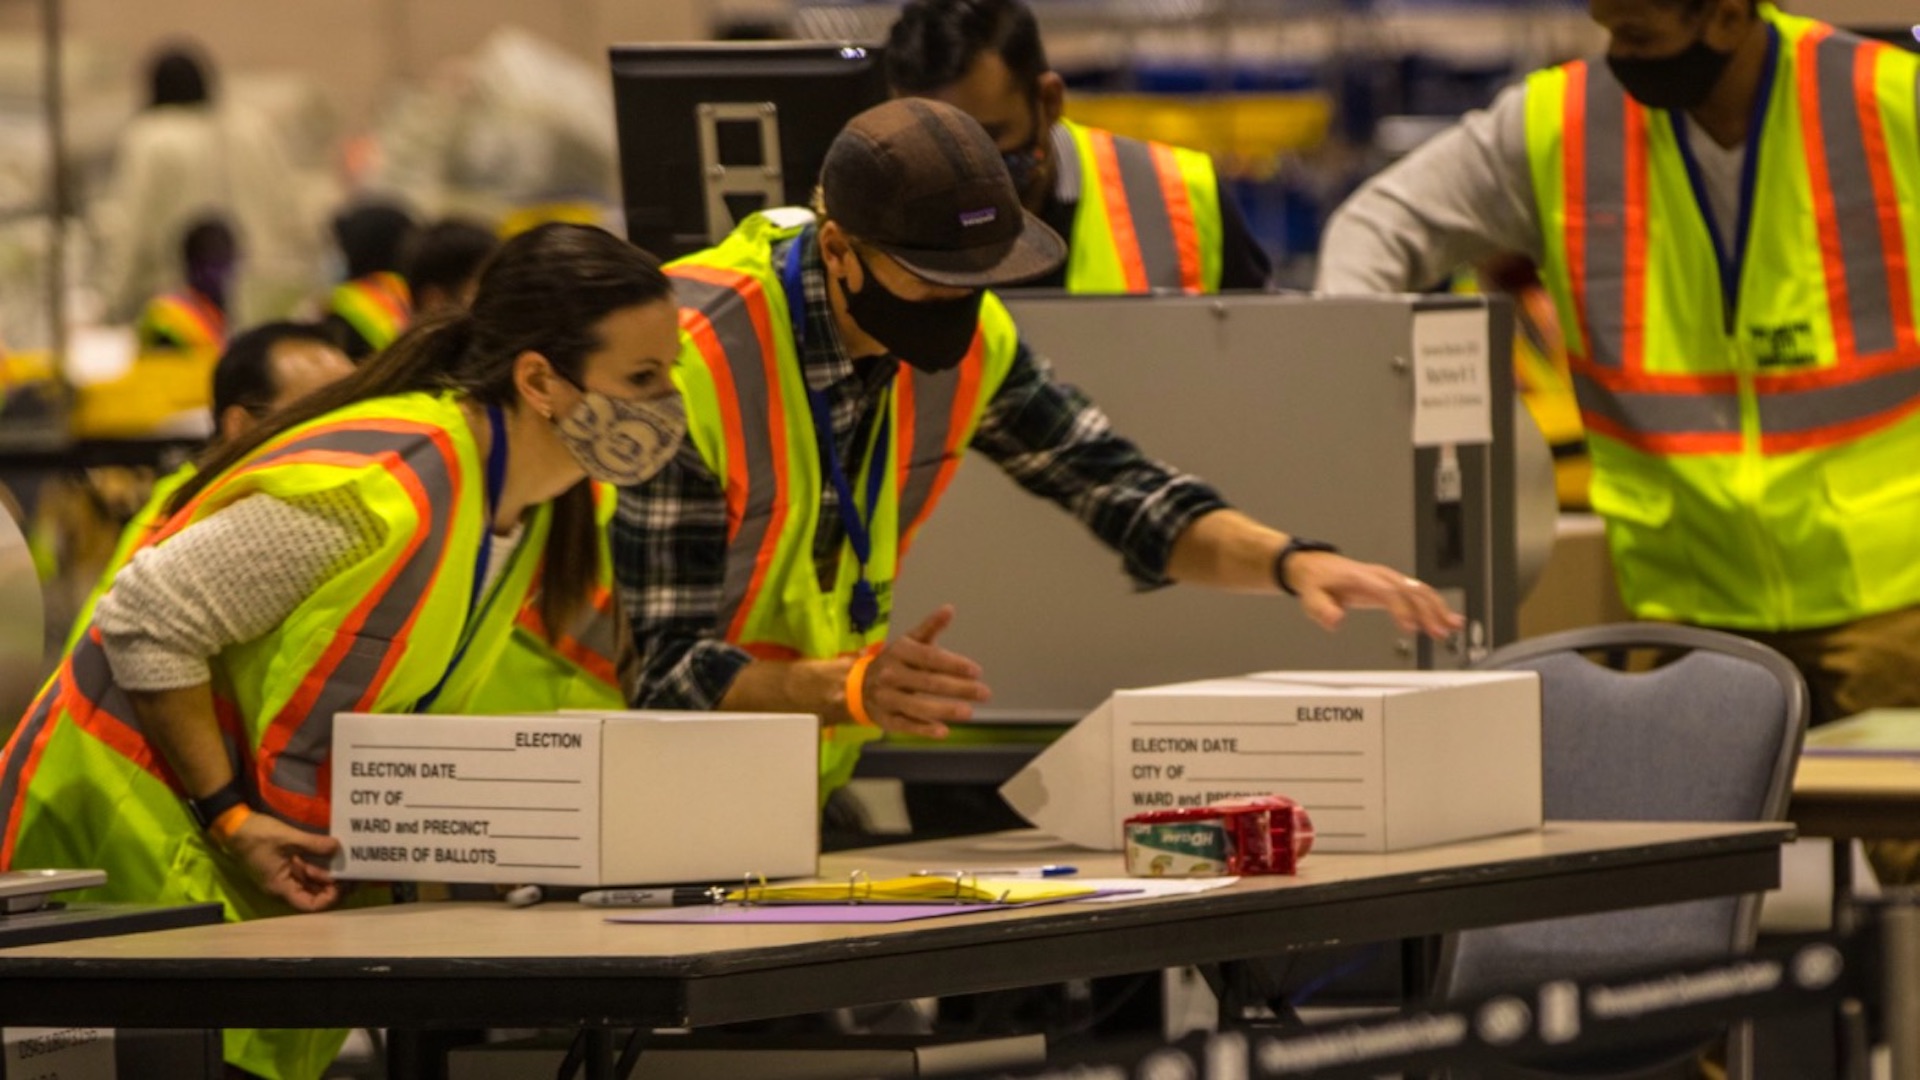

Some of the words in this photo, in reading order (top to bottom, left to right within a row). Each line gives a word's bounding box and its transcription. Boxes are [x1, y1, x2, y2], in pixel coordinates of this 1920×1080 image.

[1296, 707, 1364, 721] ELECTION
[515, 732, 582, 748] ELECTION
[1131, 738, 1198, 753] ELECTION
[1202, 738, 1238, 753] DATE
[350, 762, 417, 778] ELECTION
[420, 763, 457, 779] DATE
[1132, 765, 1162, 779] CITY
[1166, 765, 1185, 779] OF
[350, 790, 380, 805] CITY
[384, 791, 403, 805] OF
[1132, 792, 1174, 806] WARD
[1178, 792, 1201, 806] and
[350, 818, 391, 834] WARD
[395, 819, 418, 834] and
[423, 820, 490, 836] PRECINCT
[350, 847, 408, 862] NUMBER
[412, 848, 430, 862] OF
[435, 849, 497, 864] BALLOTS
